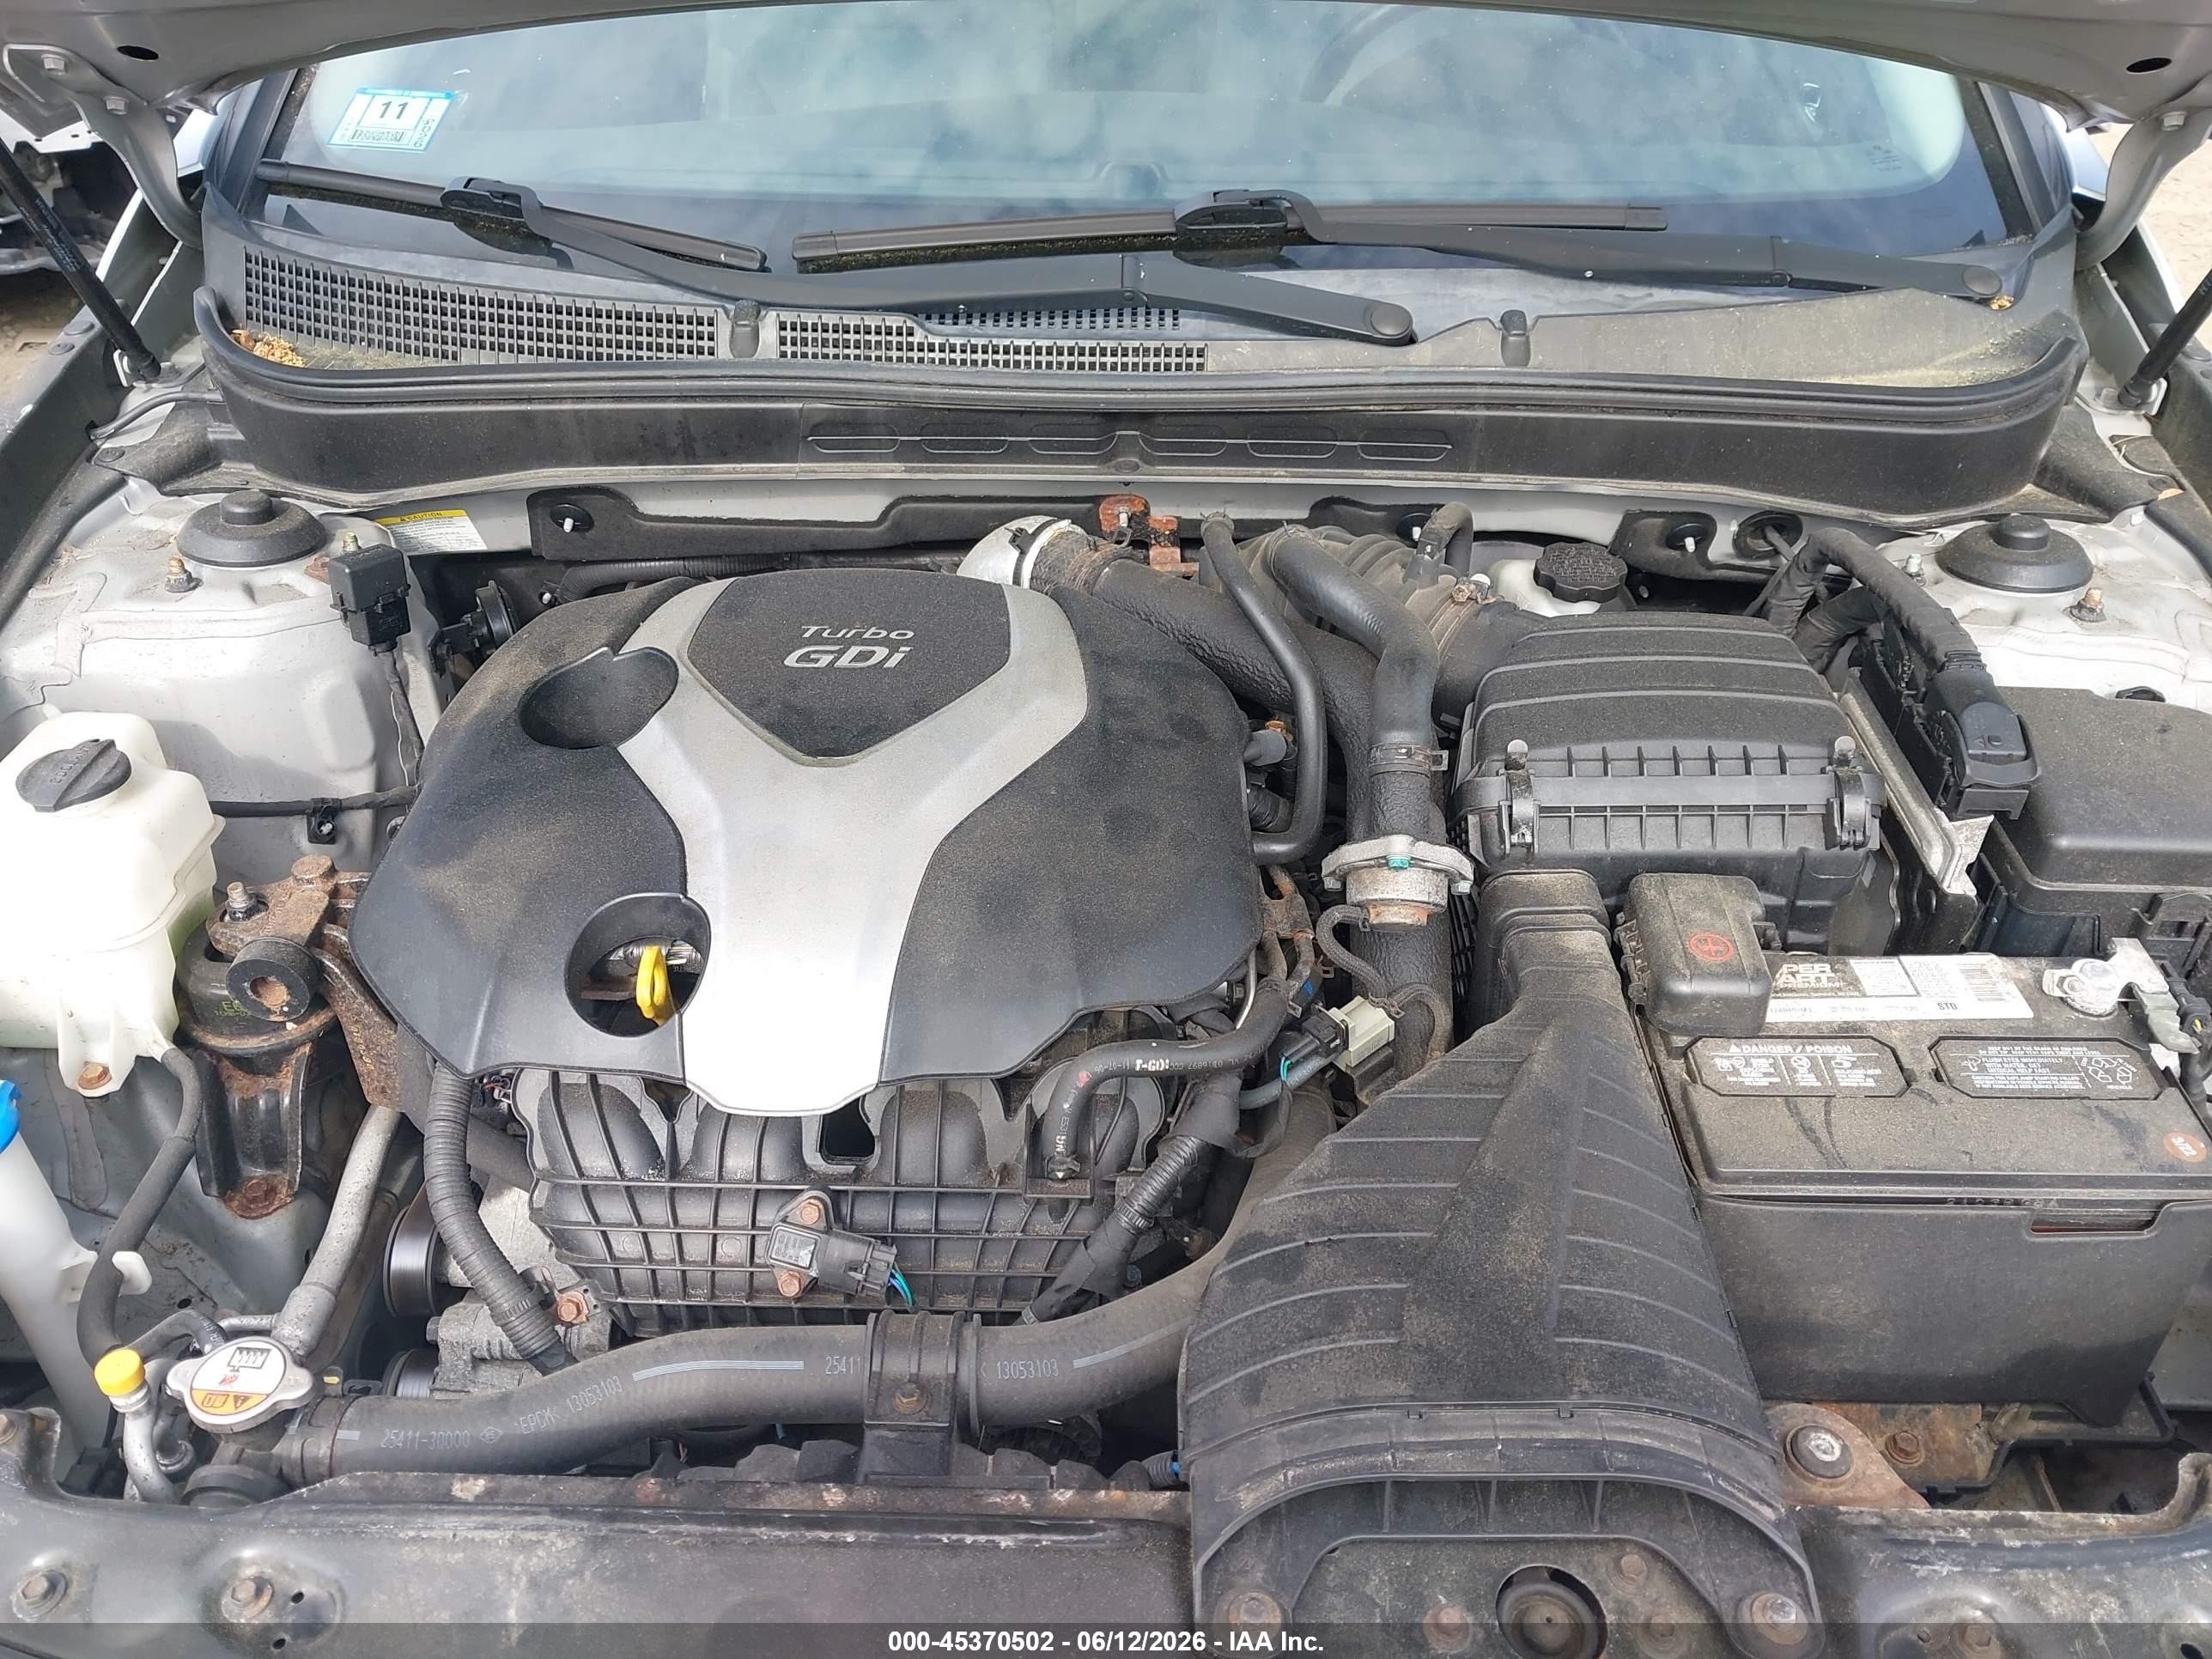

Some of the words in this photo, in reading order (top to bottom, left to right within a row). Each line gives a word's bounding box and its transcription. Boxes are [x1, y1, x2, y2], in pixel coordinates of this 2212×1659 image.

[379, 100, 409, 119] 11
[407, 512, 442, 520] CAUTION
[801, 624, 915, 641] Turbo
[783, 644, 913, 670] GDi
[1781, 963, 1832, 973] PER
[1778, 973, 1837, 983] ART
[1937, 1001, 1958, 1012] STD
[1742, 1045, 1795, 1054] DANGER
[1805, 1045, 1853, 1054] POISON
[996, 1358, 1059, 1379] 13053103
